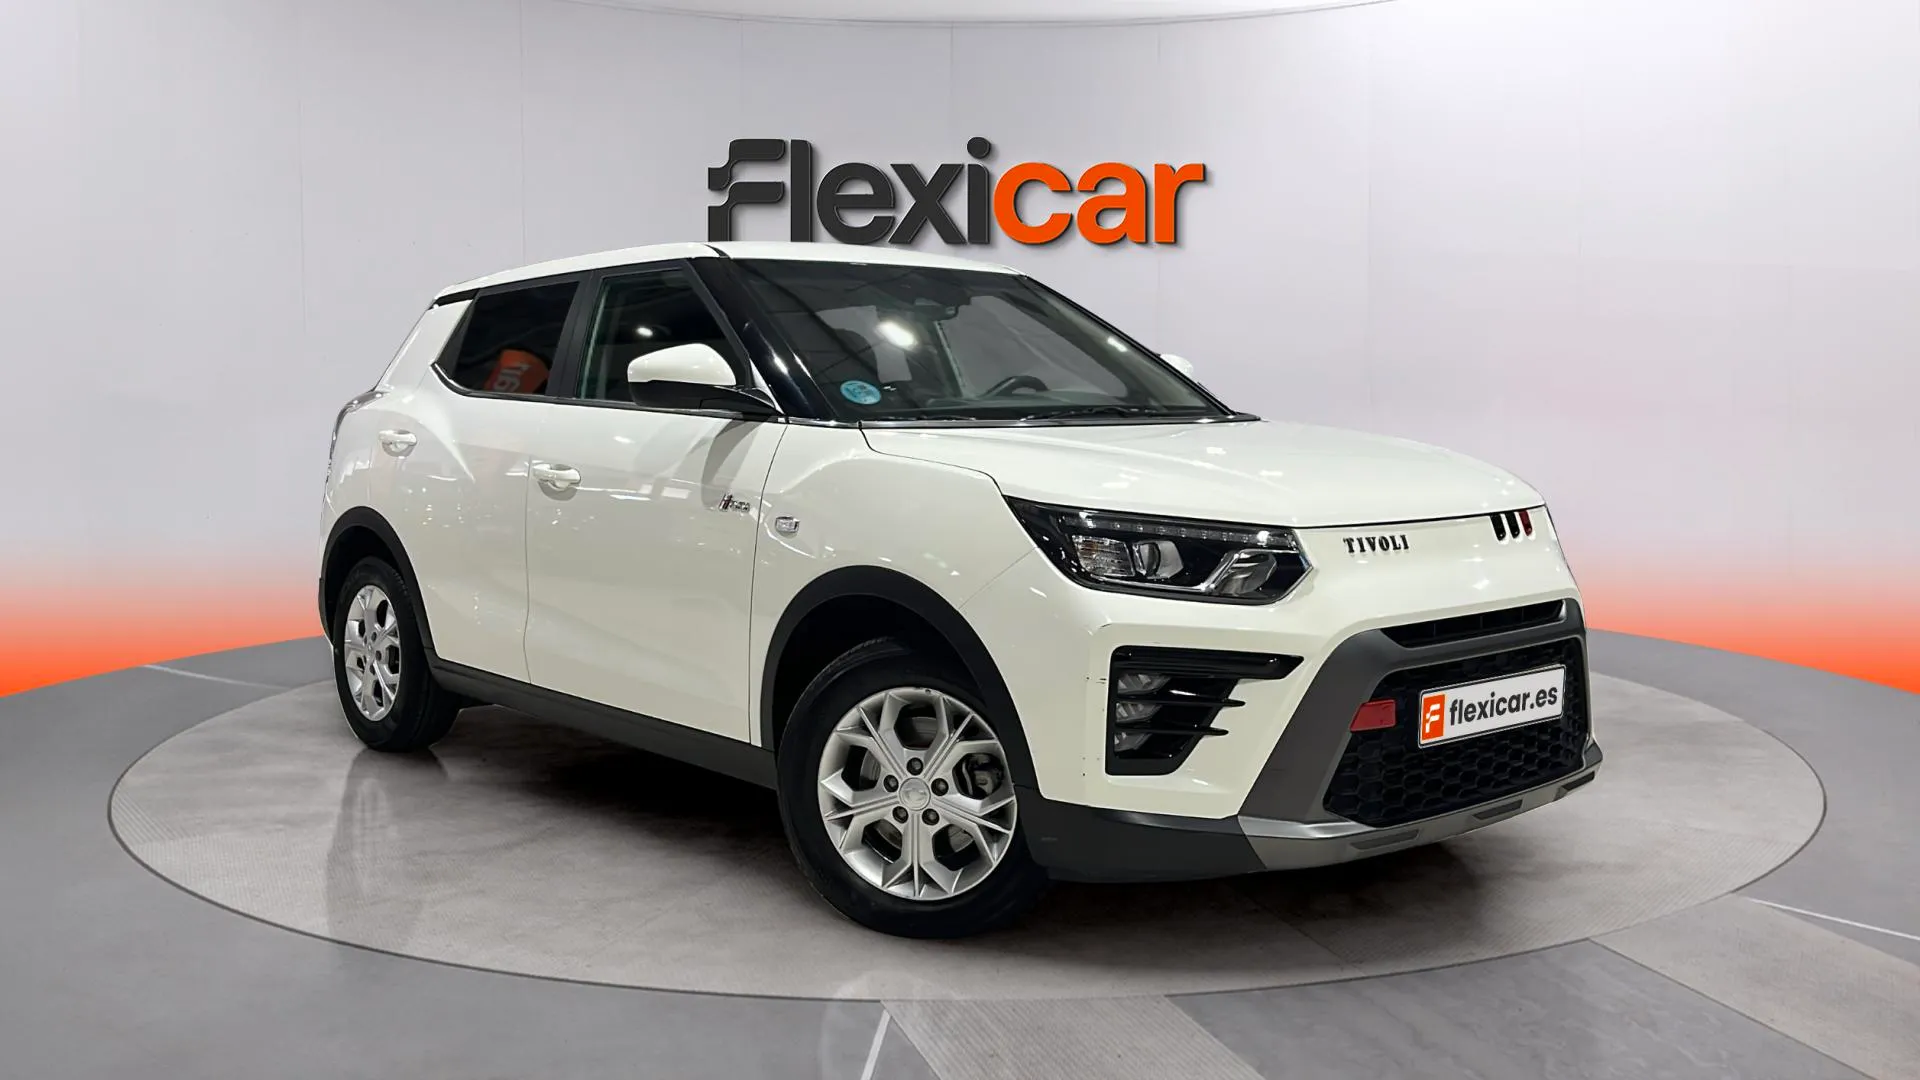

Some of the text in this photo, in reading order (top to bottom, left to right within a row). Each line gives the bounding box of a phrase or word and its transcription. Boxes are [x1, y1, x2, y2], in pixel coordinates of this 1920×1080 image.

[708, 137, 1205, 244] Flexicar
[1343, 534, 1409, 553] TIVOLI
[1450, 687, 1558, 726] flexicar.es
